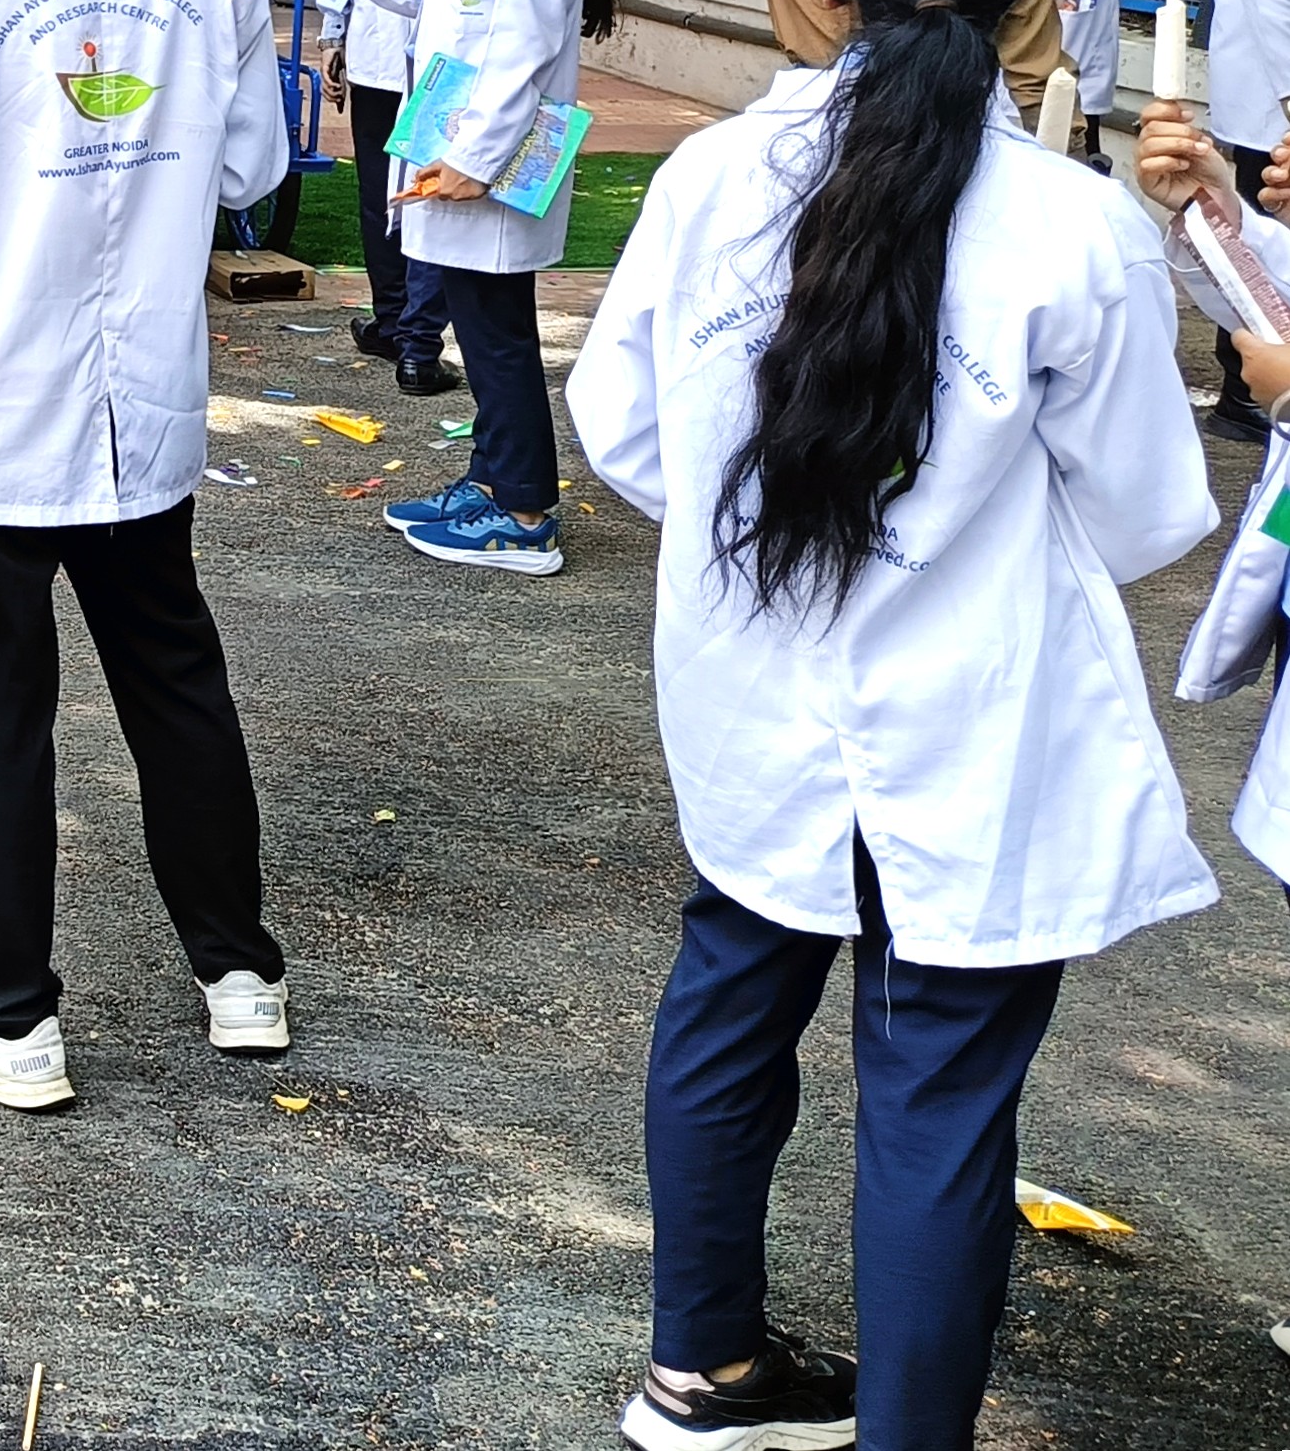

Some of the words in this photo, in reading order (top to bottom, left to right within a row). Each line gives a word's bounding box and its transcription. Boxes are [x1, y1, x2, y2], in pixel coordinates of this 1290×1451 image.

[29, 20, 57, 45] AND
[56, 2, 117, 25] RESEARCH
[121, 4, 170, 32] CENTRE
[64, 143, 109, 159] GREATER
[112, 139, 148, 152] NOIDA
[689, 308, 741, 349] ISHAN
[943, 335, 1007, 406] COLLEGE
[10, 1053, 51, 1075] PUMA
